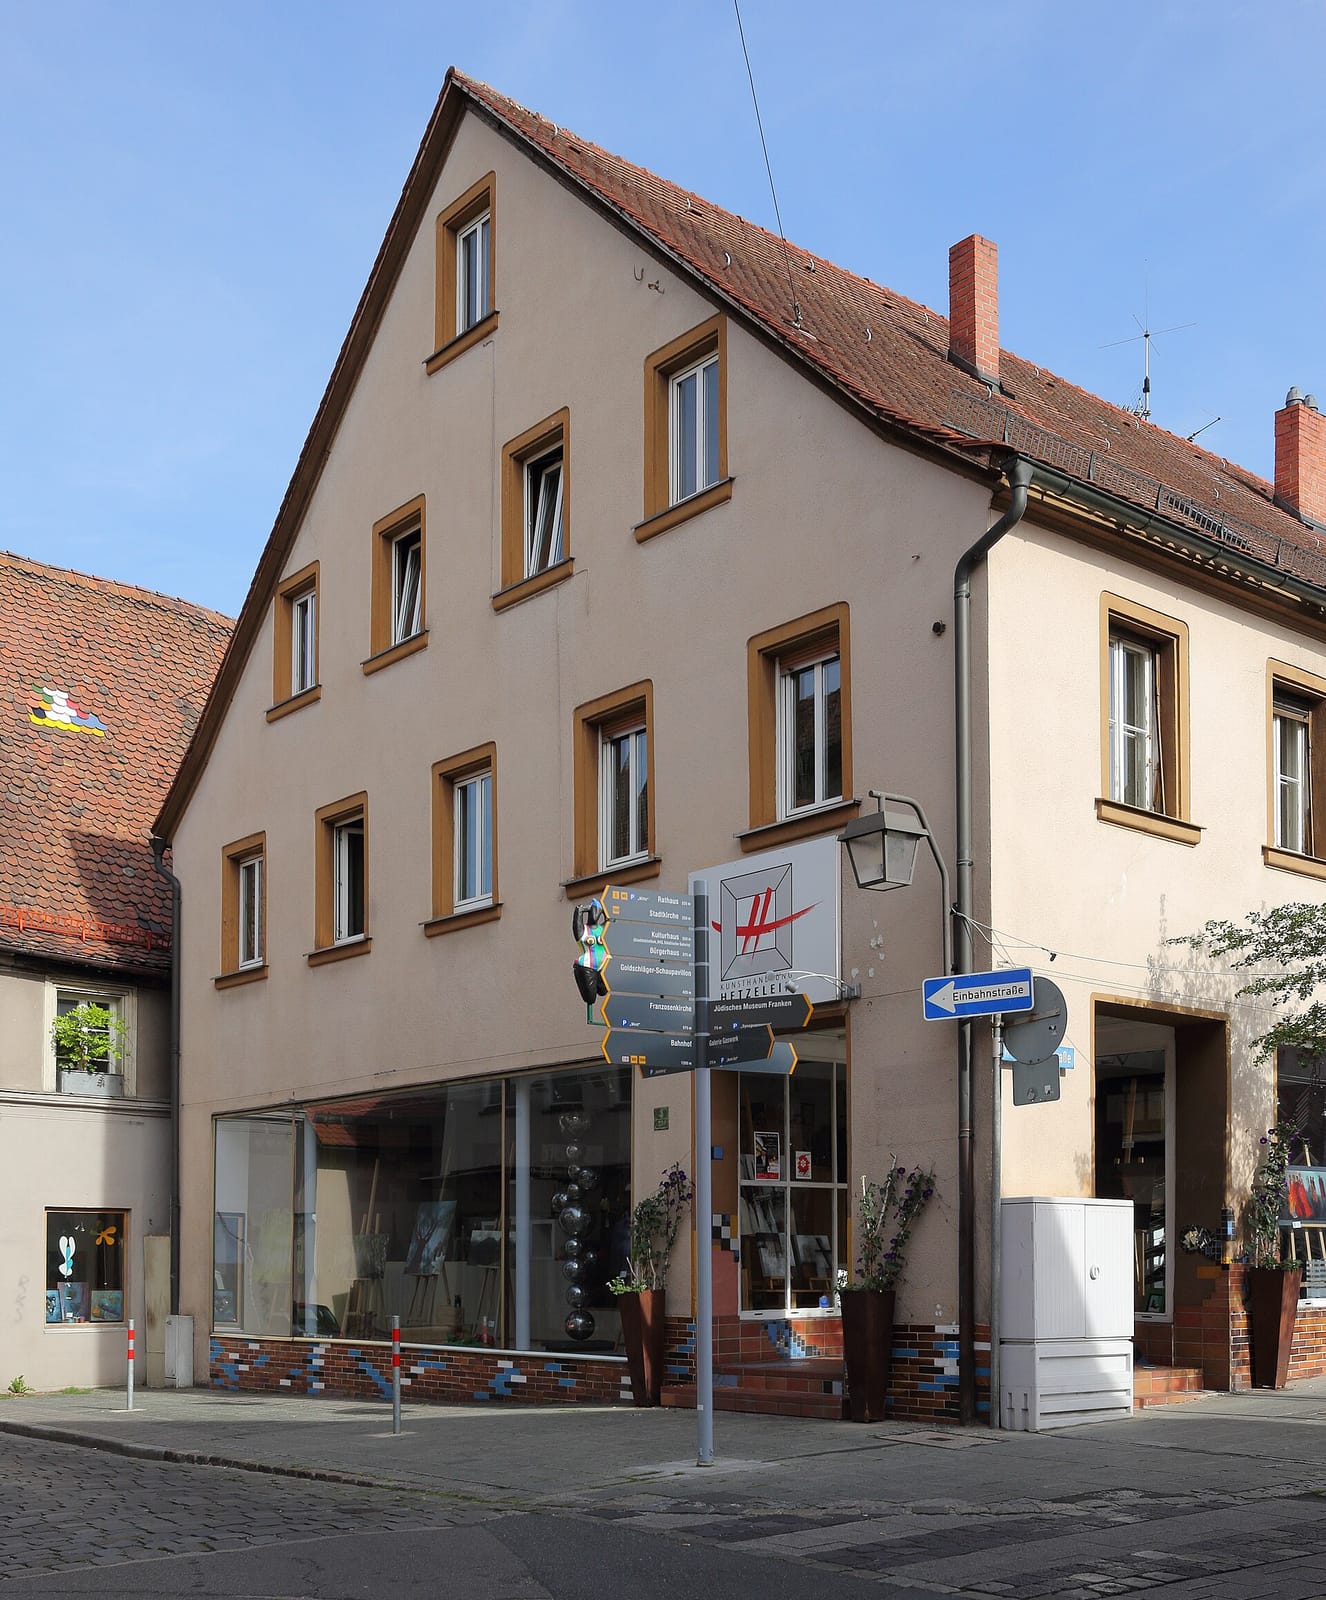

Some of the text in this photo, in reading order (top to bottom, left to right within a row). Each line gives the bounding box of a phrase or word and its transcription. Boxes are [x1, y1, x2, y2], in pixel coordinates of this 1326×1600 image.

[657, 895, 679, 905] Rathaus
[649, 909, 679, 920] Stadtkirche
[651, 931, 680, 941] Kulturhaus
[649, 946, 680, 957] Bürgerhaus
[620, 963, 692, 977] Goldschläger-Schaupavillon
[952, 984, 1025, 1002] Einbahnstraße
[649, 1002, 692, 1013] Franzosenkirche
[713, 1000, 792, 1012] Jüdisches Museum Franken
[670, 1039, 693, 1048] Bahnhof
